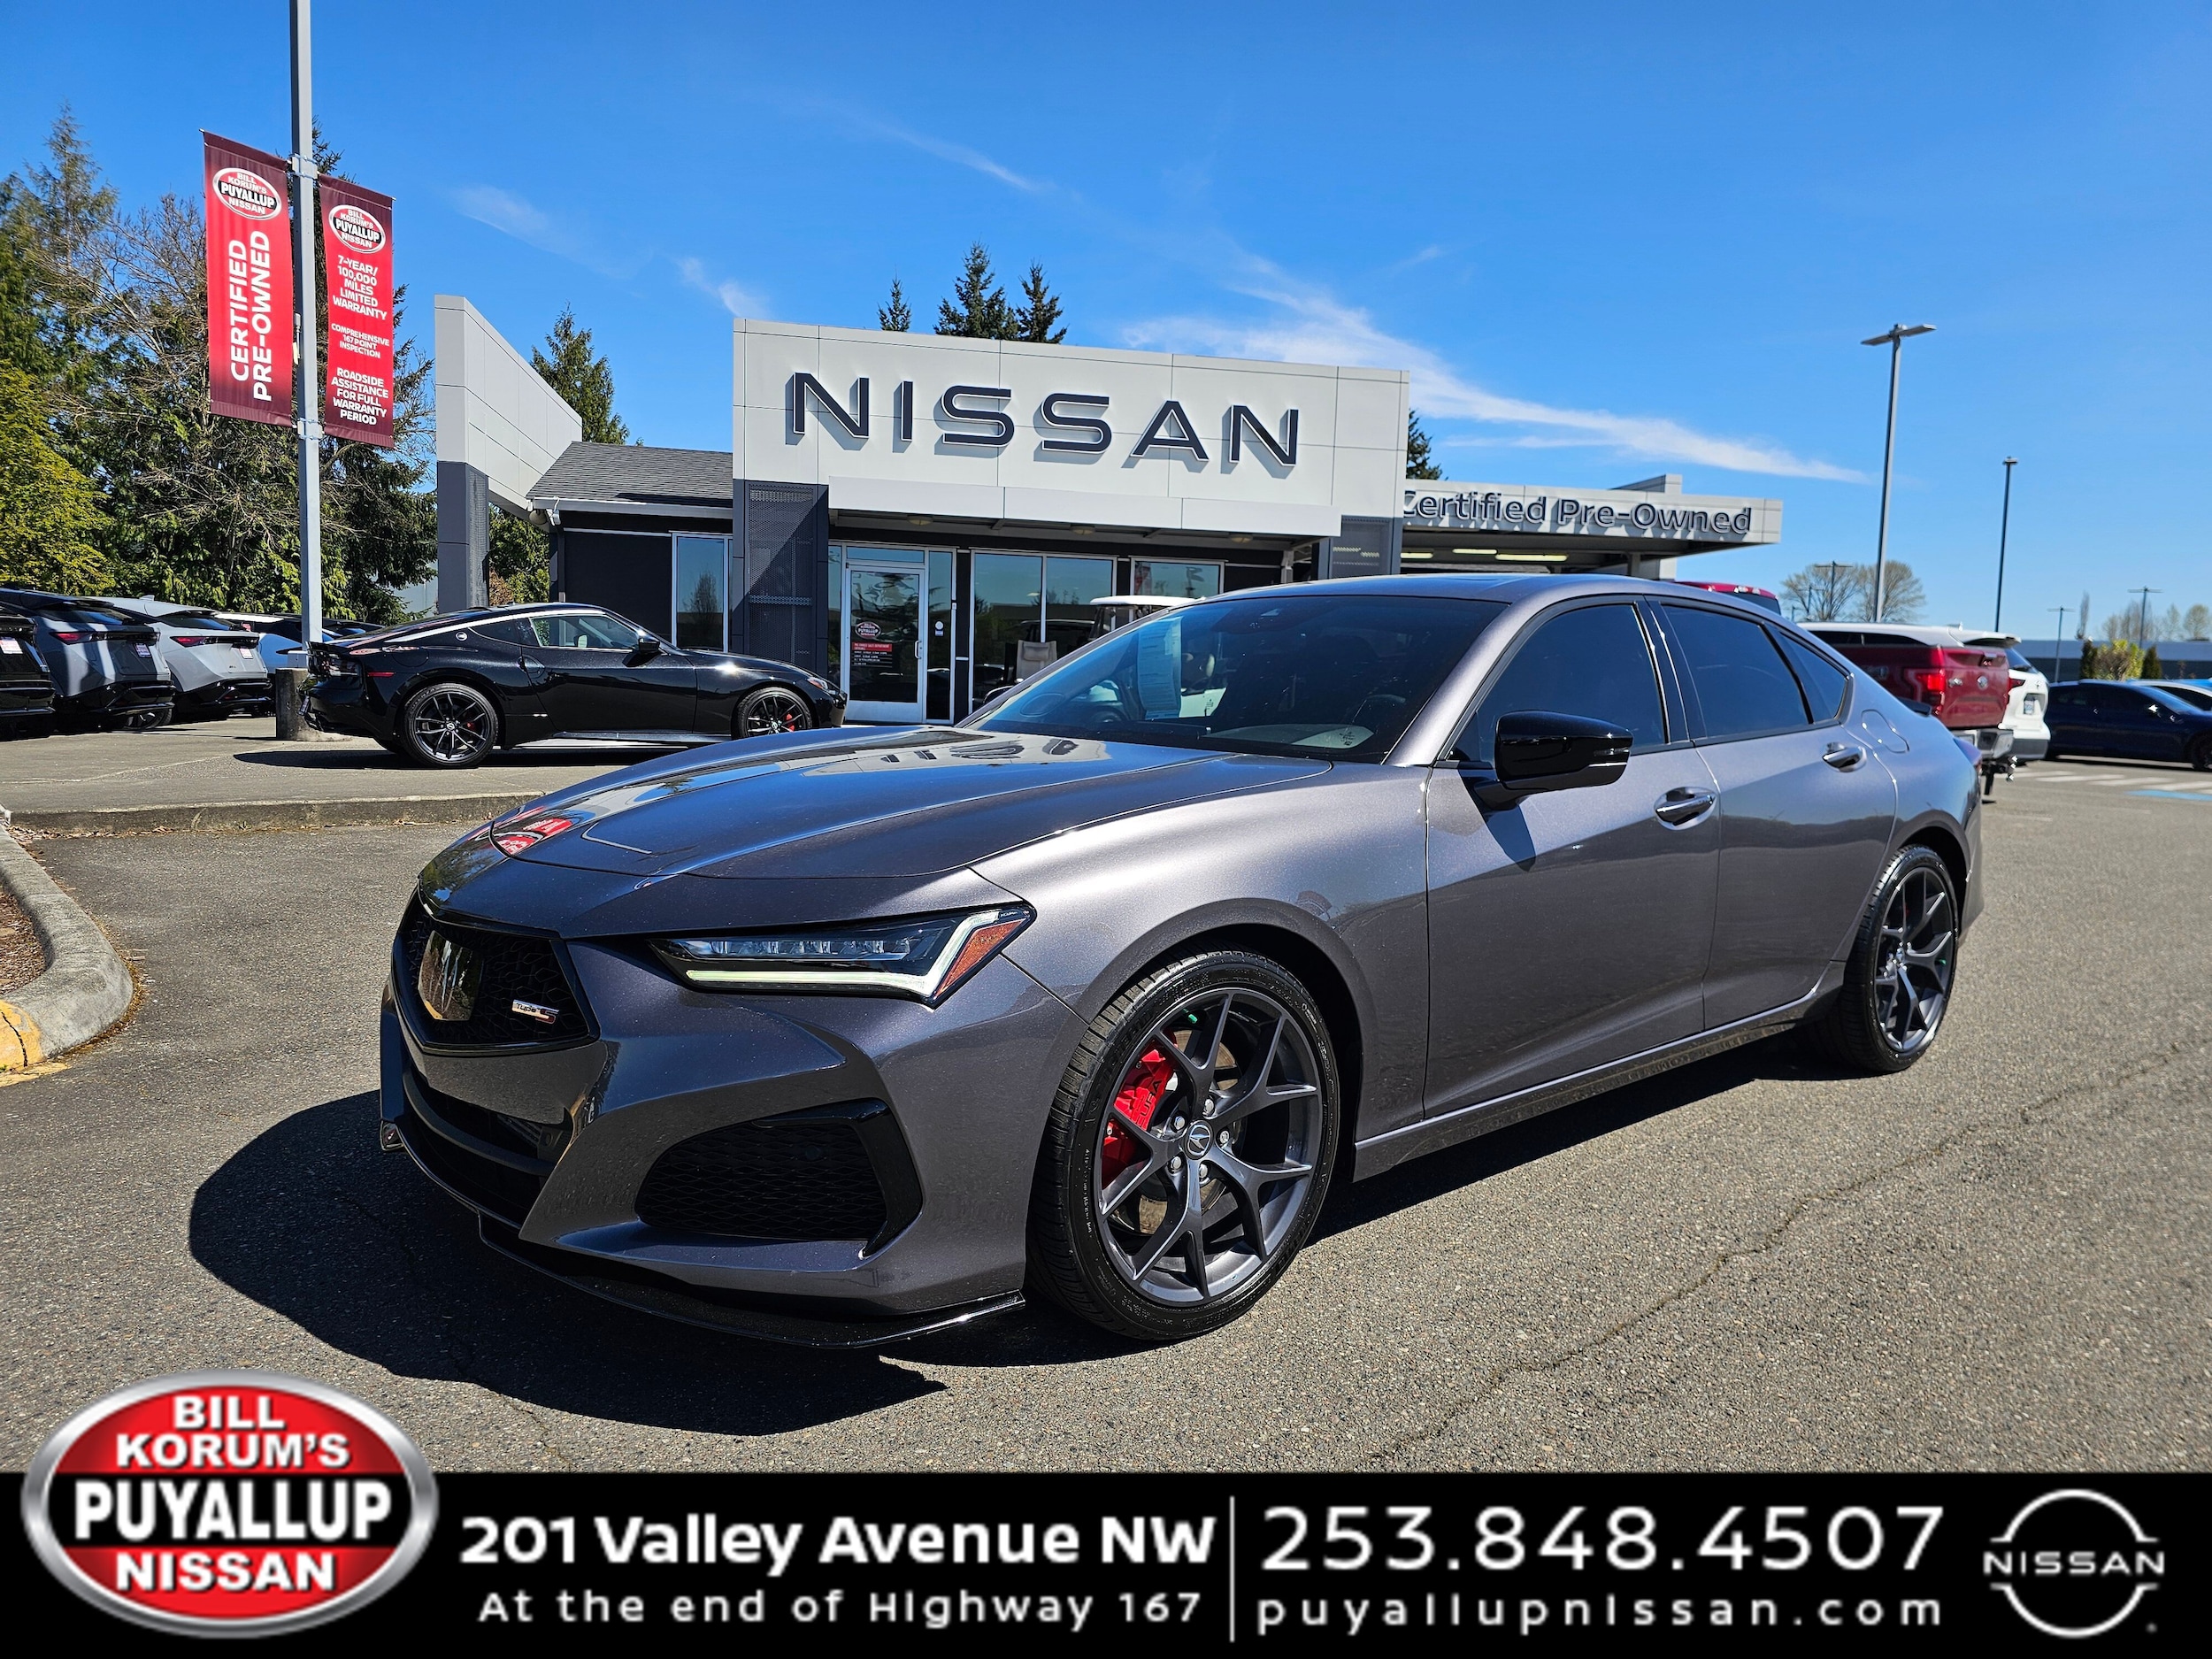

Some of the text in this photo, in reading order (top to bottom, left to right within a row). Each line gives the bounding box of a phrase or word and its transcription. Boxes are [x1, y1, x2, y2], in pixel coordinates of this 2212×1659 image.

[228, 175, 266, 194] KORUM'S
[237, 173, 257, 184] BILL
[221, 181, 275, 207] PUYALLUP
[229, 196, 265, 214] NISSAN
[348, 209, 365, 219] BILL
[335, 218, 380, 242] PUYALLUP
[340, 212, 373, 229] KORUM'S
[341, 231, 372, 248] NISSAN
[337, 254, 378, 276] 7-YEAR/
[337, 265, 377, 286] 100,000
[340, 287, 378, 307] LIMITED
[344, 278, 373, 296] MILES
[228, 240, 249, 381] CERTIFIED
[250, 231, 272, 402] PRE-OWNED
[333, 295, 388, 320] WARRANTY
[331, 323, 390, 346] COMPREHENSIVE
[354, 338, 377, 349] POINT
[339, 341, 380, 358] INSPECTION
[331, 377, 388, 398] ASSISTANCE
[337, 367, 384, 388] ROADSIDE
[333, 397, 387, 418] WARRANTY
[337, 388, 381, 407] FOR FULL
[340, 410, 377, 425] PERIOD
[793, 372, 1299, 466] NISSAN
[1558, 499, 1753, 534] Pre-Owned
